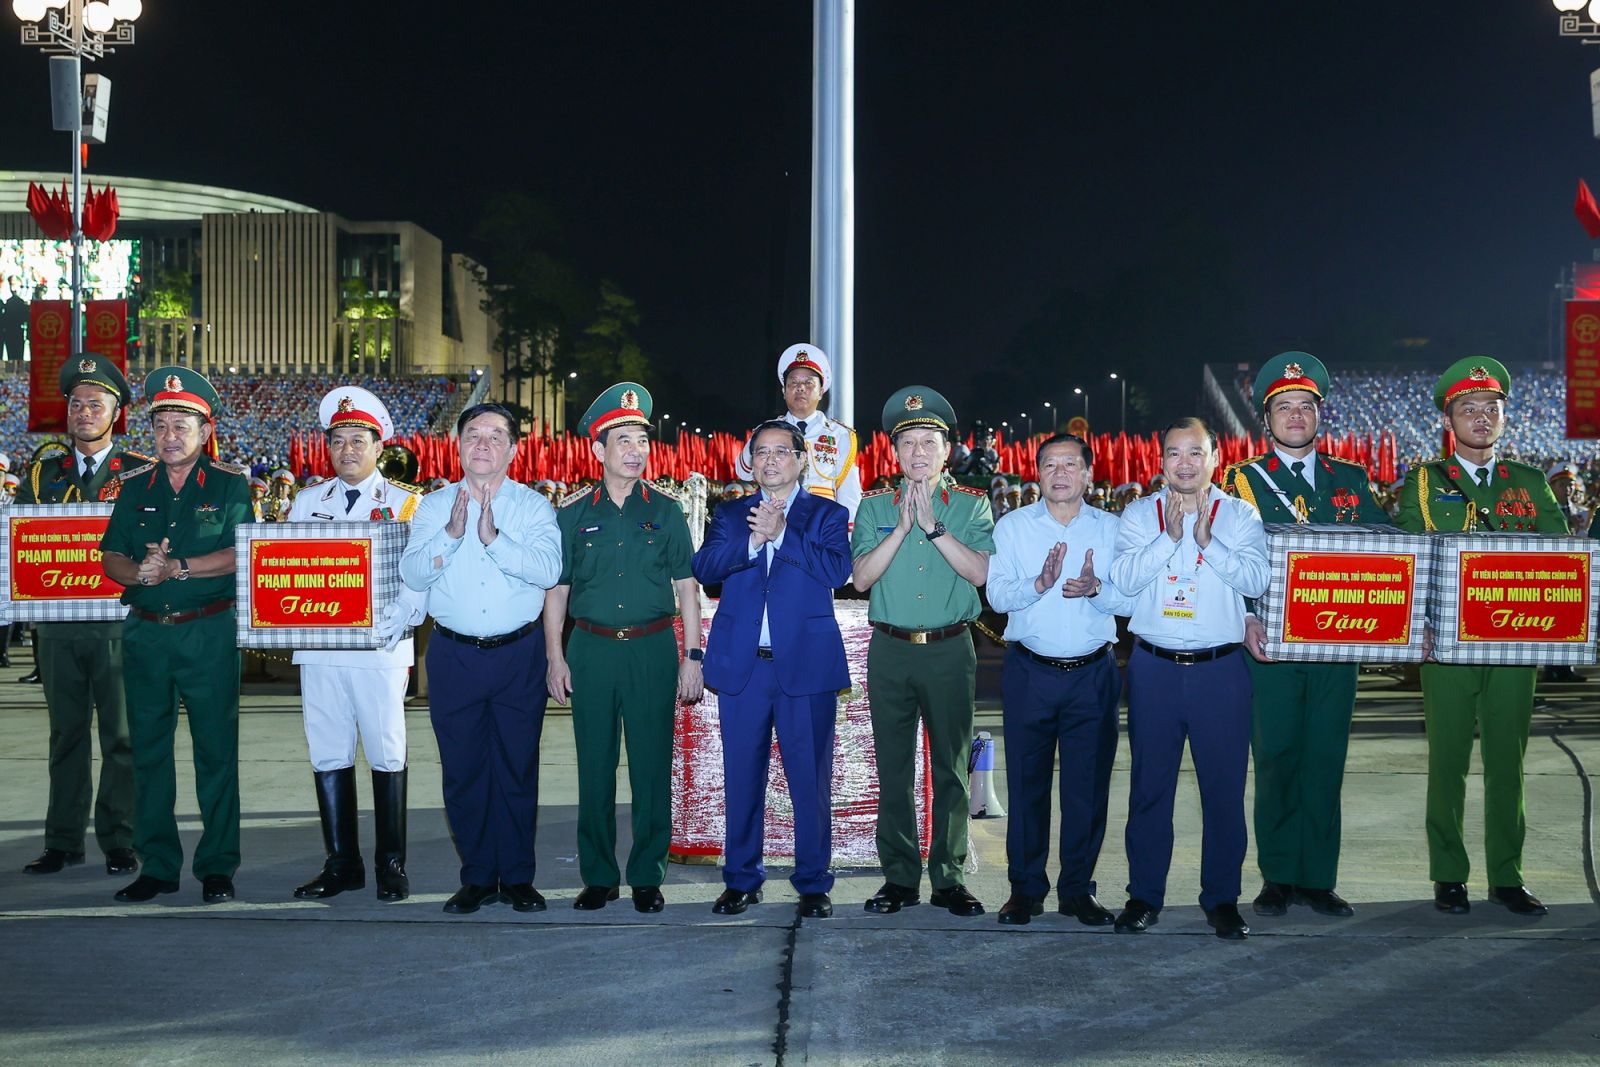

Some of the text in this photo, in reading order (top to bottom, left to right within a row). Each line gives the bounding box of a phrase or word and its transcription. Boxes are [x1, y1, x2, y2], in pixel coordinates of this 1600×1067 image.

[17, 549, 52, 566] PHẠM
[56, 549, 86, 562] MINH
[41, 570, 102, 589] Tặng
[257, 571, 364, 591] PHẠM MINH CHÍNH
[1293, 587, 1405, 605] PHẠM MINH CHÍNH
[1467, 585, 1582, 604] PHẠM MINH CHÍNH
[281, 596, 341, 616] Tặng
[1316, 610, 1379, 633] Tặng
[1491, 609, 1555, 631] Tặng
